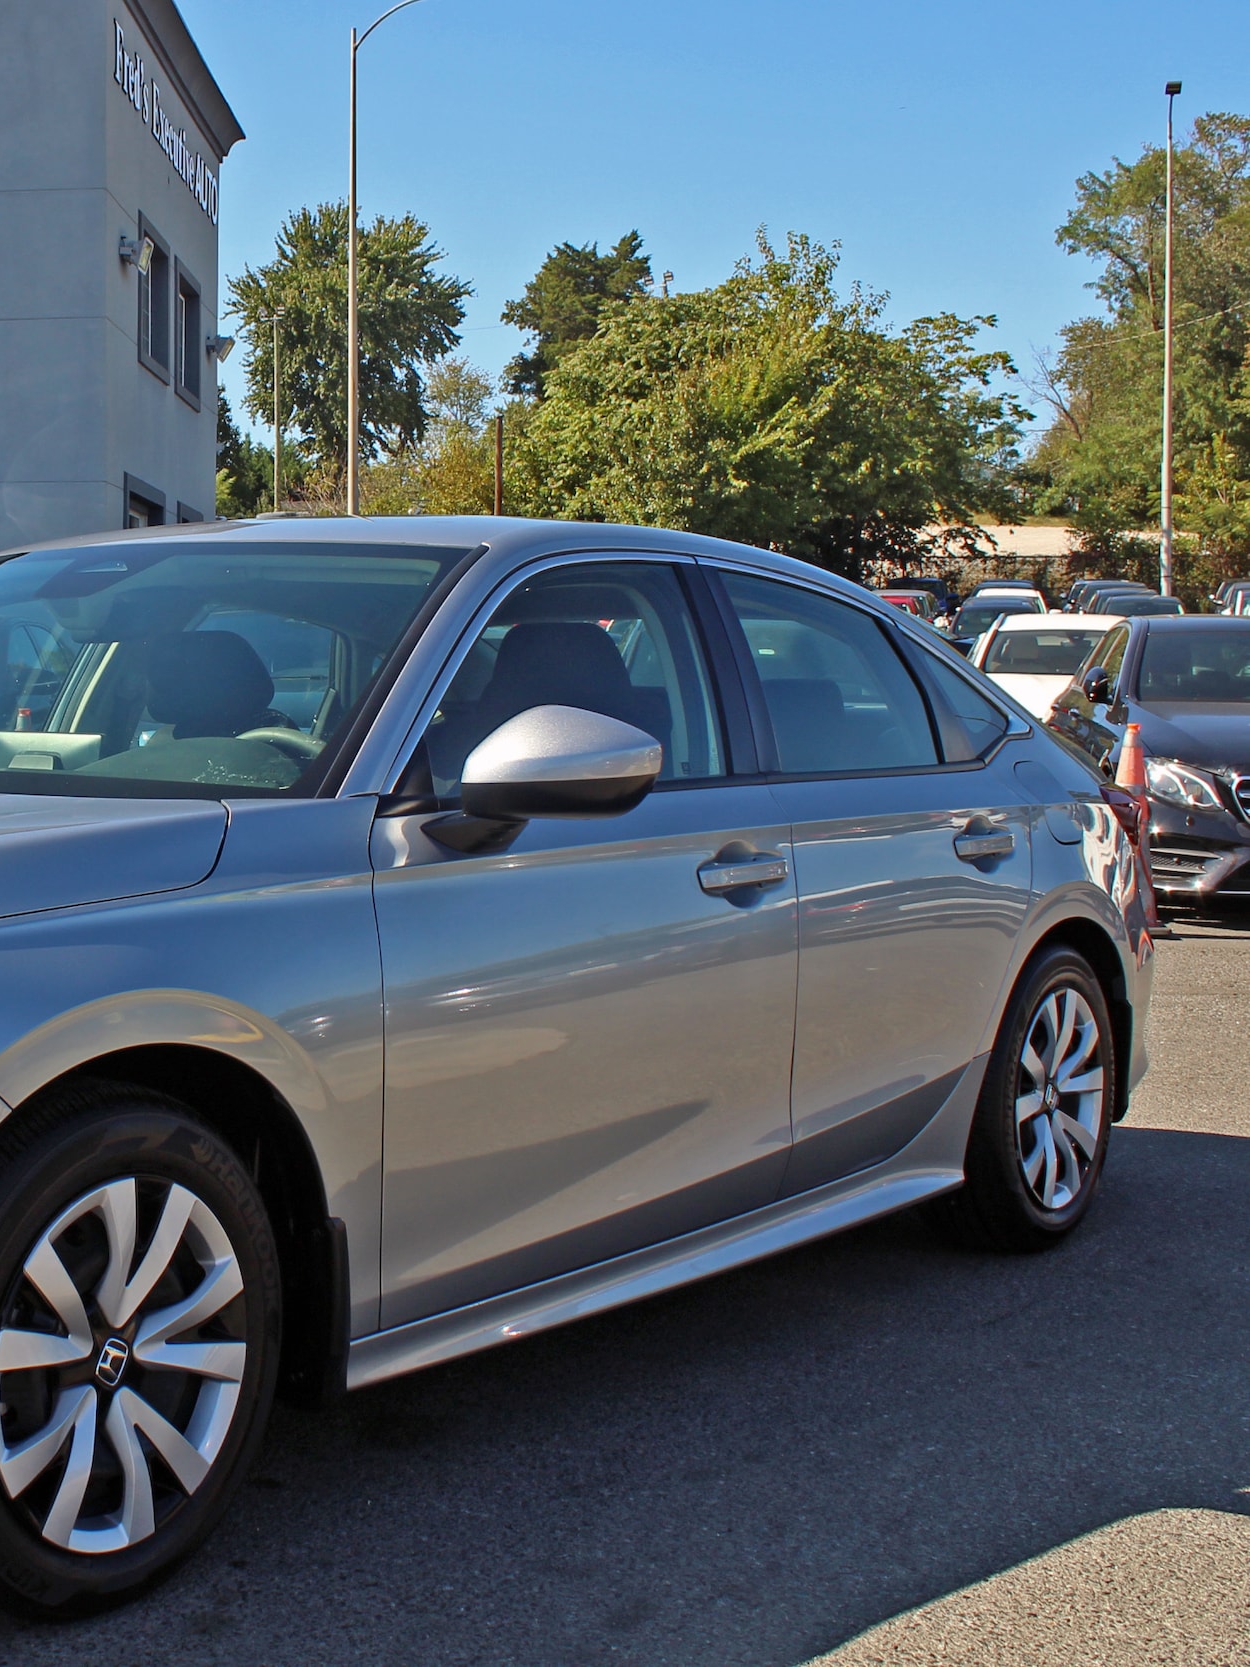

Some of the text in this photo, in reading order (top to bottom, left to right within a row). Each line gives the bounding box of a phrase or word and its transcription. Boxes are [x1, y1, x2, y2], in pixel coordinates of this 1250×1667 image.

[114, 18, 219, 226] Fred's Executive AUTO
